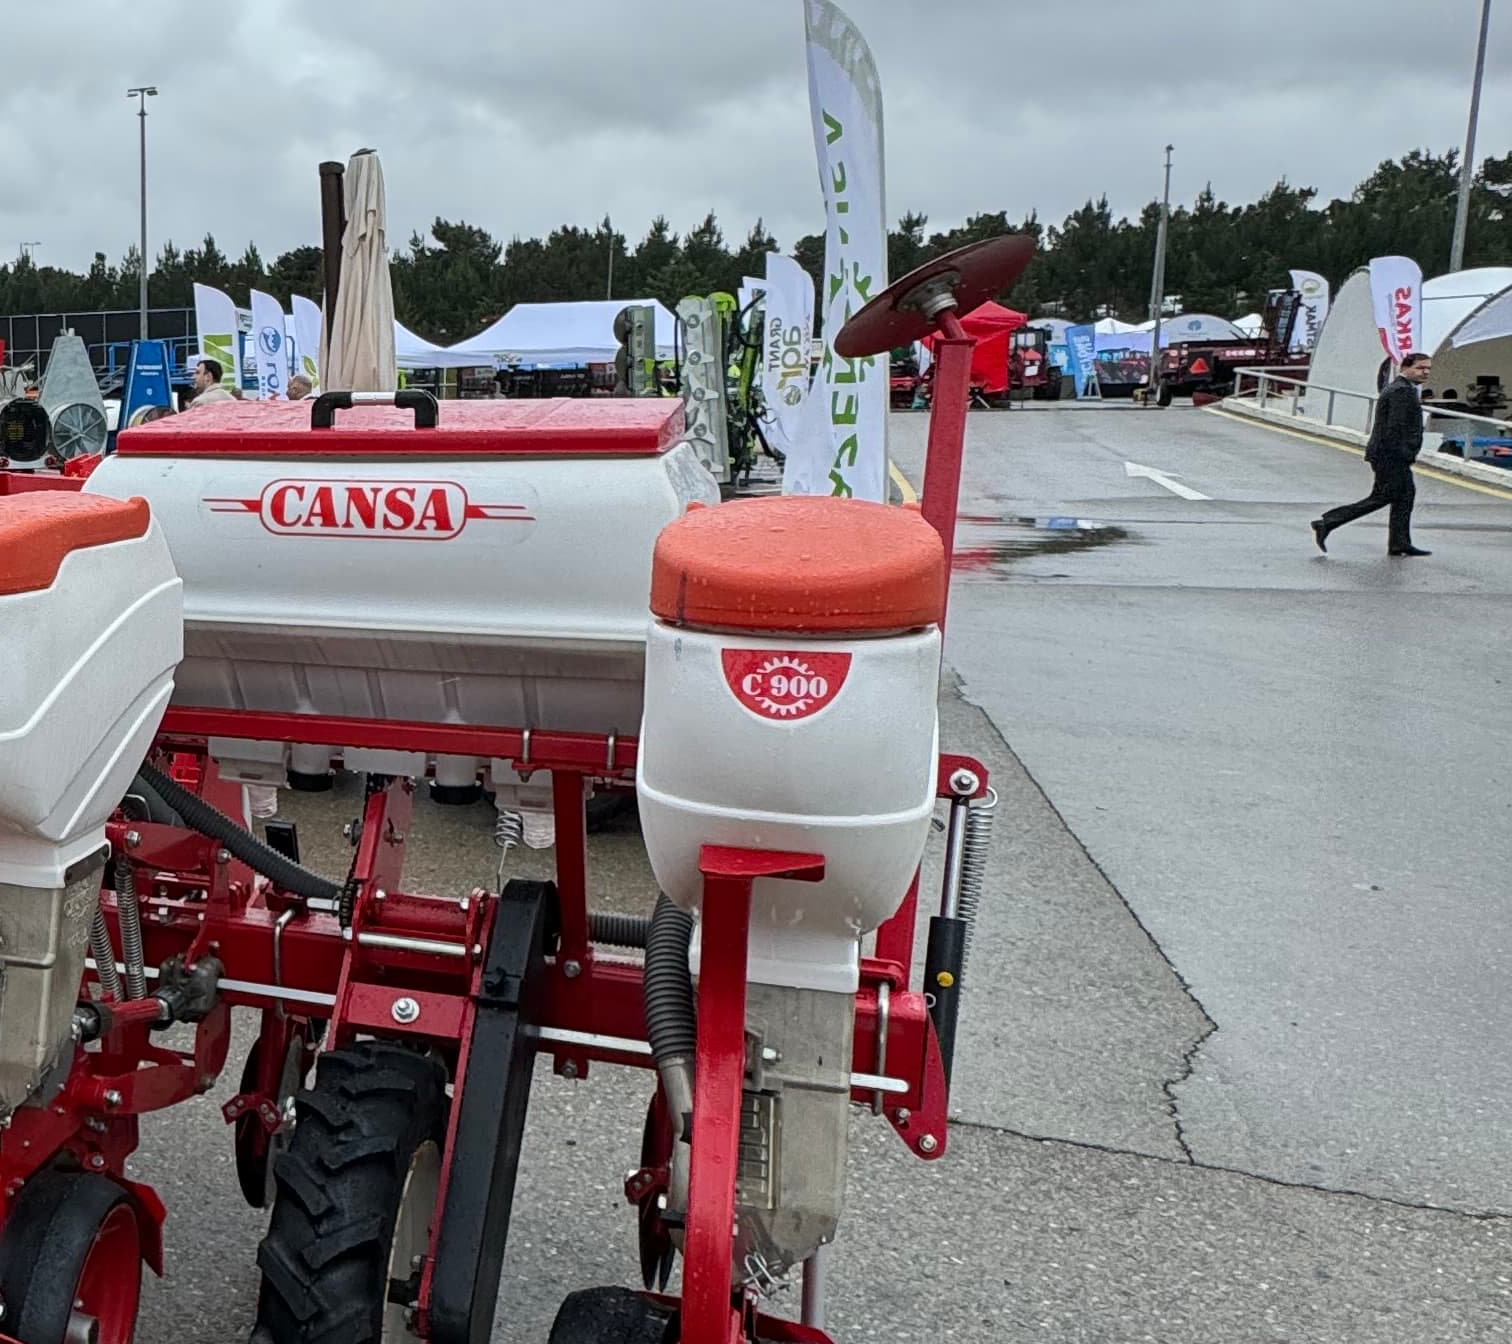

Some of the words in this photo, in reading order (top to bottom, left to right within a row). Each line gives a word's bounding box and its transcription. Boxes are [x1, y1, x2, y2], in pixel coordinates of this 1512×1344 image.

[270, 485, 455, 531] CANSA
[742, 673, 762, 696] C
[770, 674, 828, 698] 900
